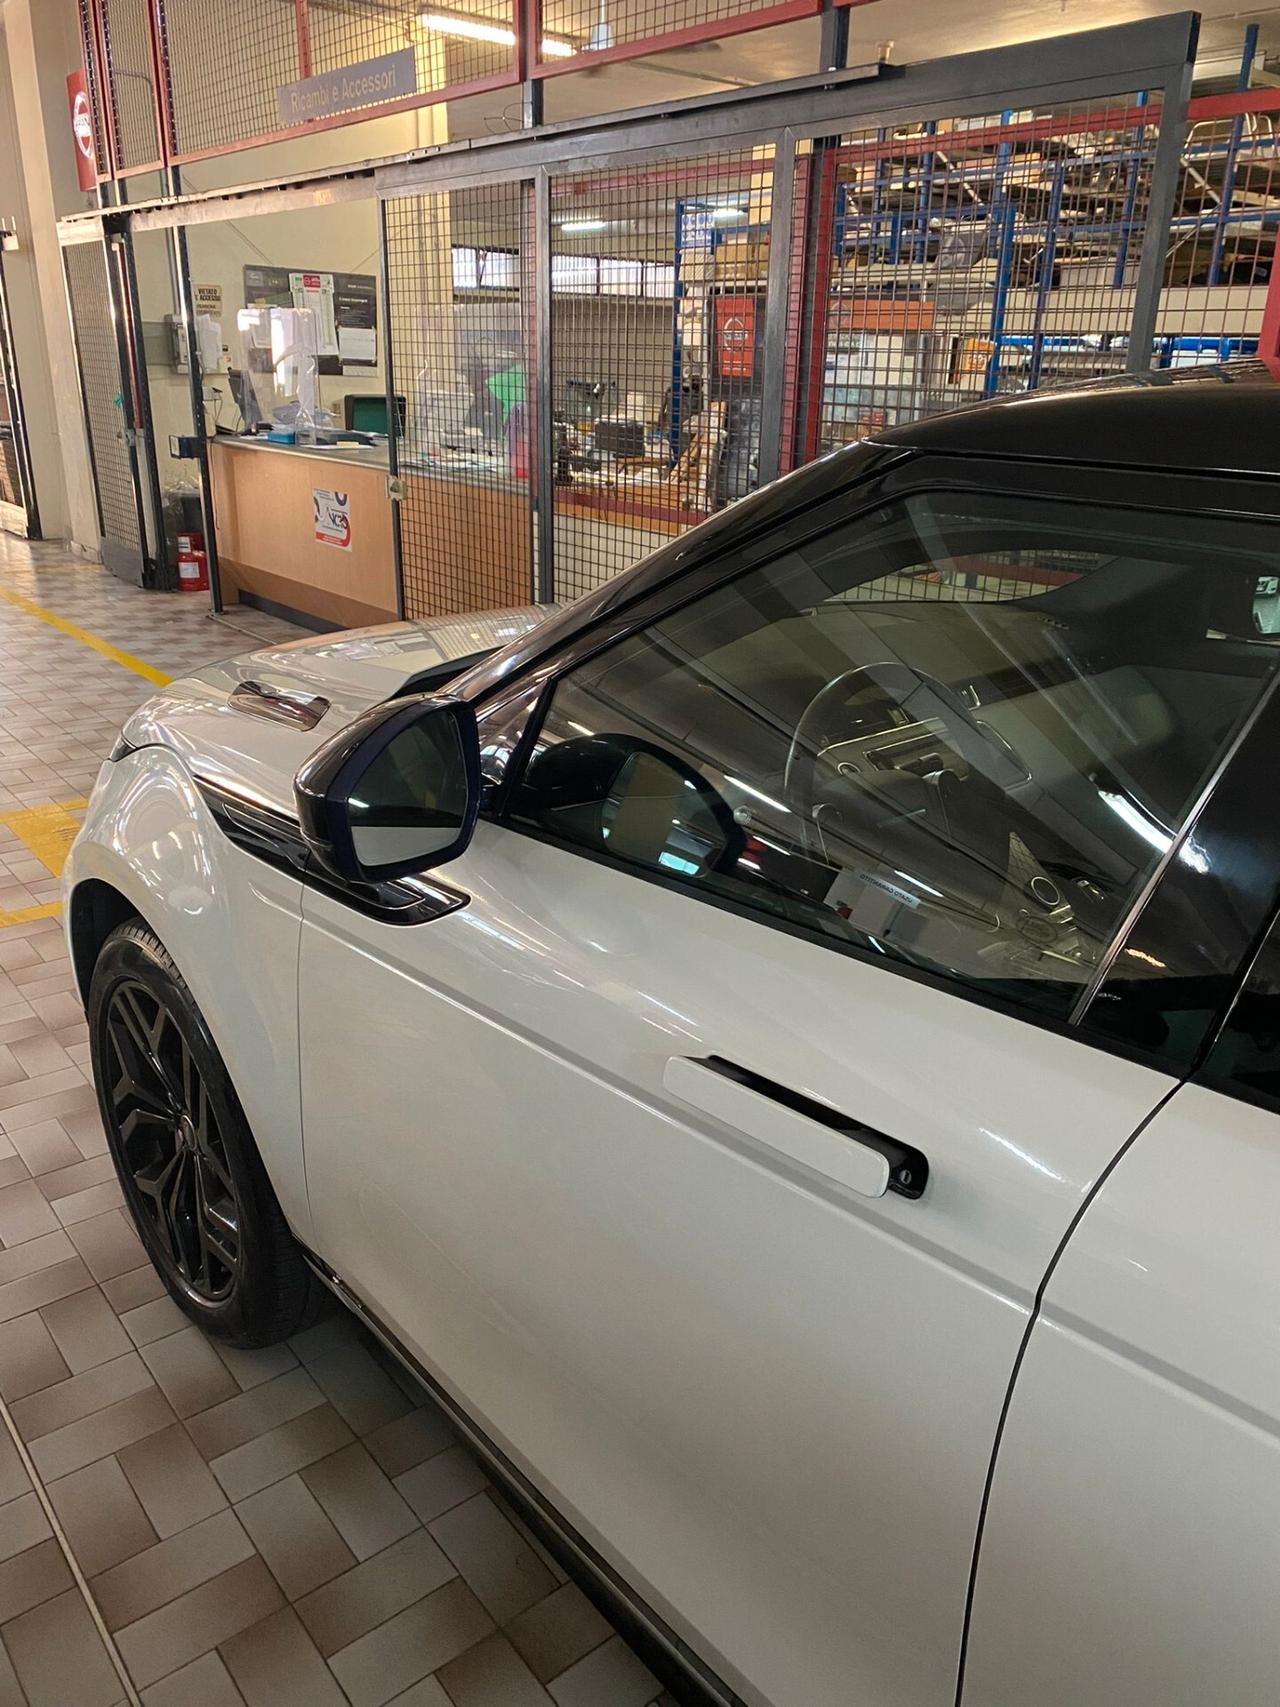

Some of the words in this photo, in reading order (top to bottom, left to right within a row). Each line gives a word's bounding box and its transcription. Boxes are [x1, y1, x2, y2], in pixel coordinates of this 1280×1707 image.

[290, 85, 330, 113] Ricambi
[332, 86, 339, 102] e
[342, 65, 397, 100] Accessori
